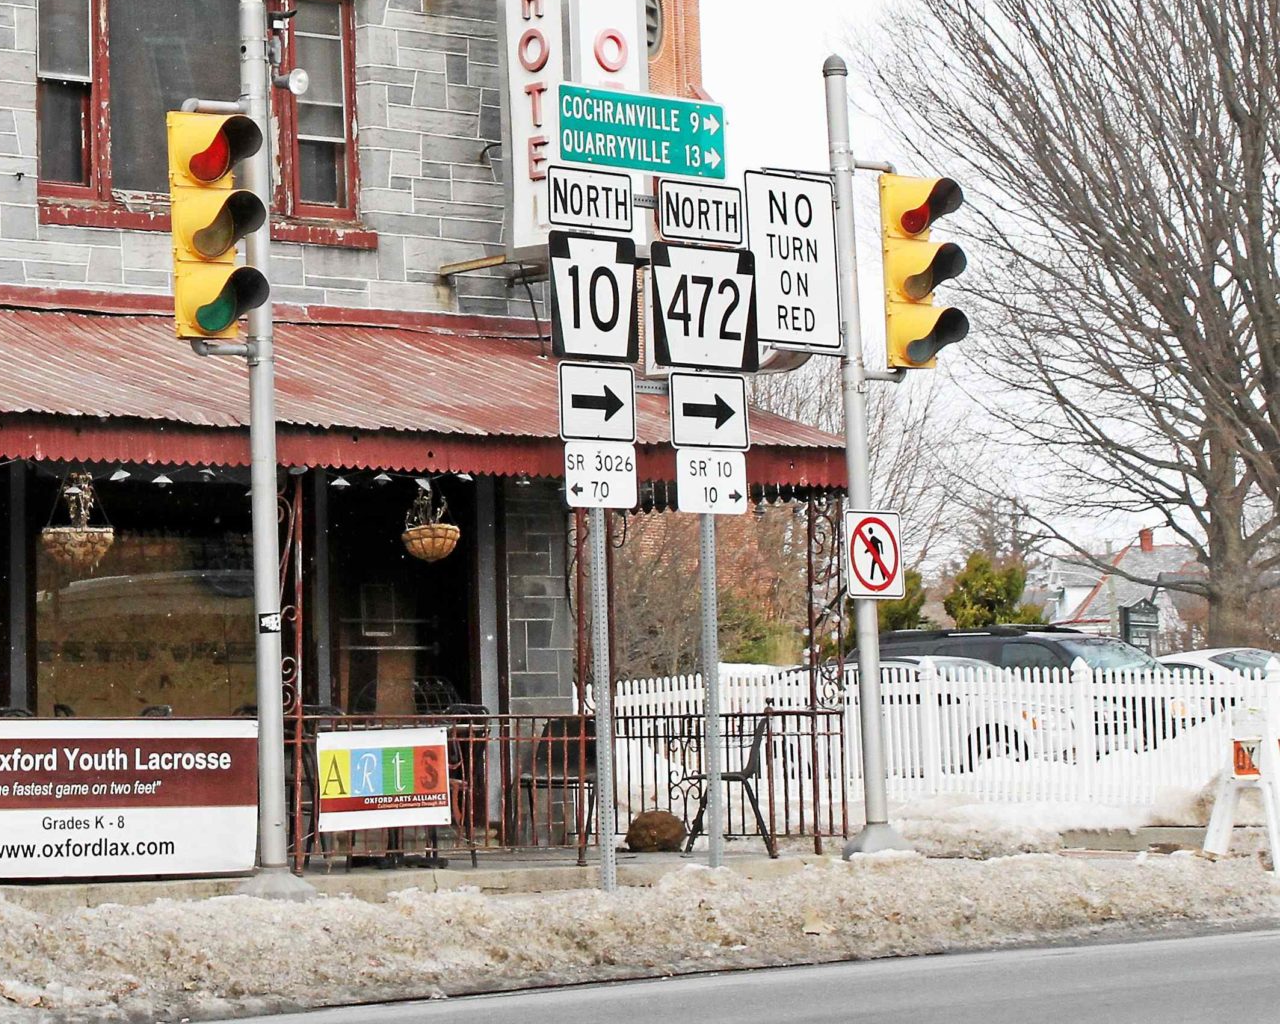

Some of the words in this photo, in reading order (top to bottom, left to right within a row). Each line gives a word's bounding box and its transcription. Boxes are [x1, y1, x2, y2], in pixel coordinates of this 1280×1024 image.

[562, 95, 680, 132] COCHRANVILLE
[690, 112, 699, 133] 9
[562, 129, 671, 164] QUARRYVILLE
[685, 144, 701, 167] 13
[553, 177, 628, 221] NORTH
[665, 191, 738, 233] NORTH
[769, 189, 813, 228] NO
[766, 233, 818, 263] TURN
[781, 270, 809, 297] ON
[568, 264, 620, 332] 10
[667, 274, 741, 341] 472
[777, 305, 816, 332] RED
[567, 454, 585, 471] SR
[595, 454, 634, 472] 3026
[689, 460, 707, 476] SR
[717, 461, 733, 478] 10
[591, 481, 610, 498] 70
[704, 486, 718, 503] 10
[63, 747, 128, 771] Youth
[135, 747, 231, 771] Lacrosse
[12, 781, 53, 796] fastest
[55, 784, 88, 798] game
[92, 784, 107, 795] on
[110, 782, 131, 795] two
[133, 780, 161, 795] feet"
[364, 796, 393, 804] OXFORD
[412, 793, 447, 801] ALLIANCE
[42, 816, 90, 830] Grades
[95, 816, 105, 829] K
[117, 816, 125, 829] 8
